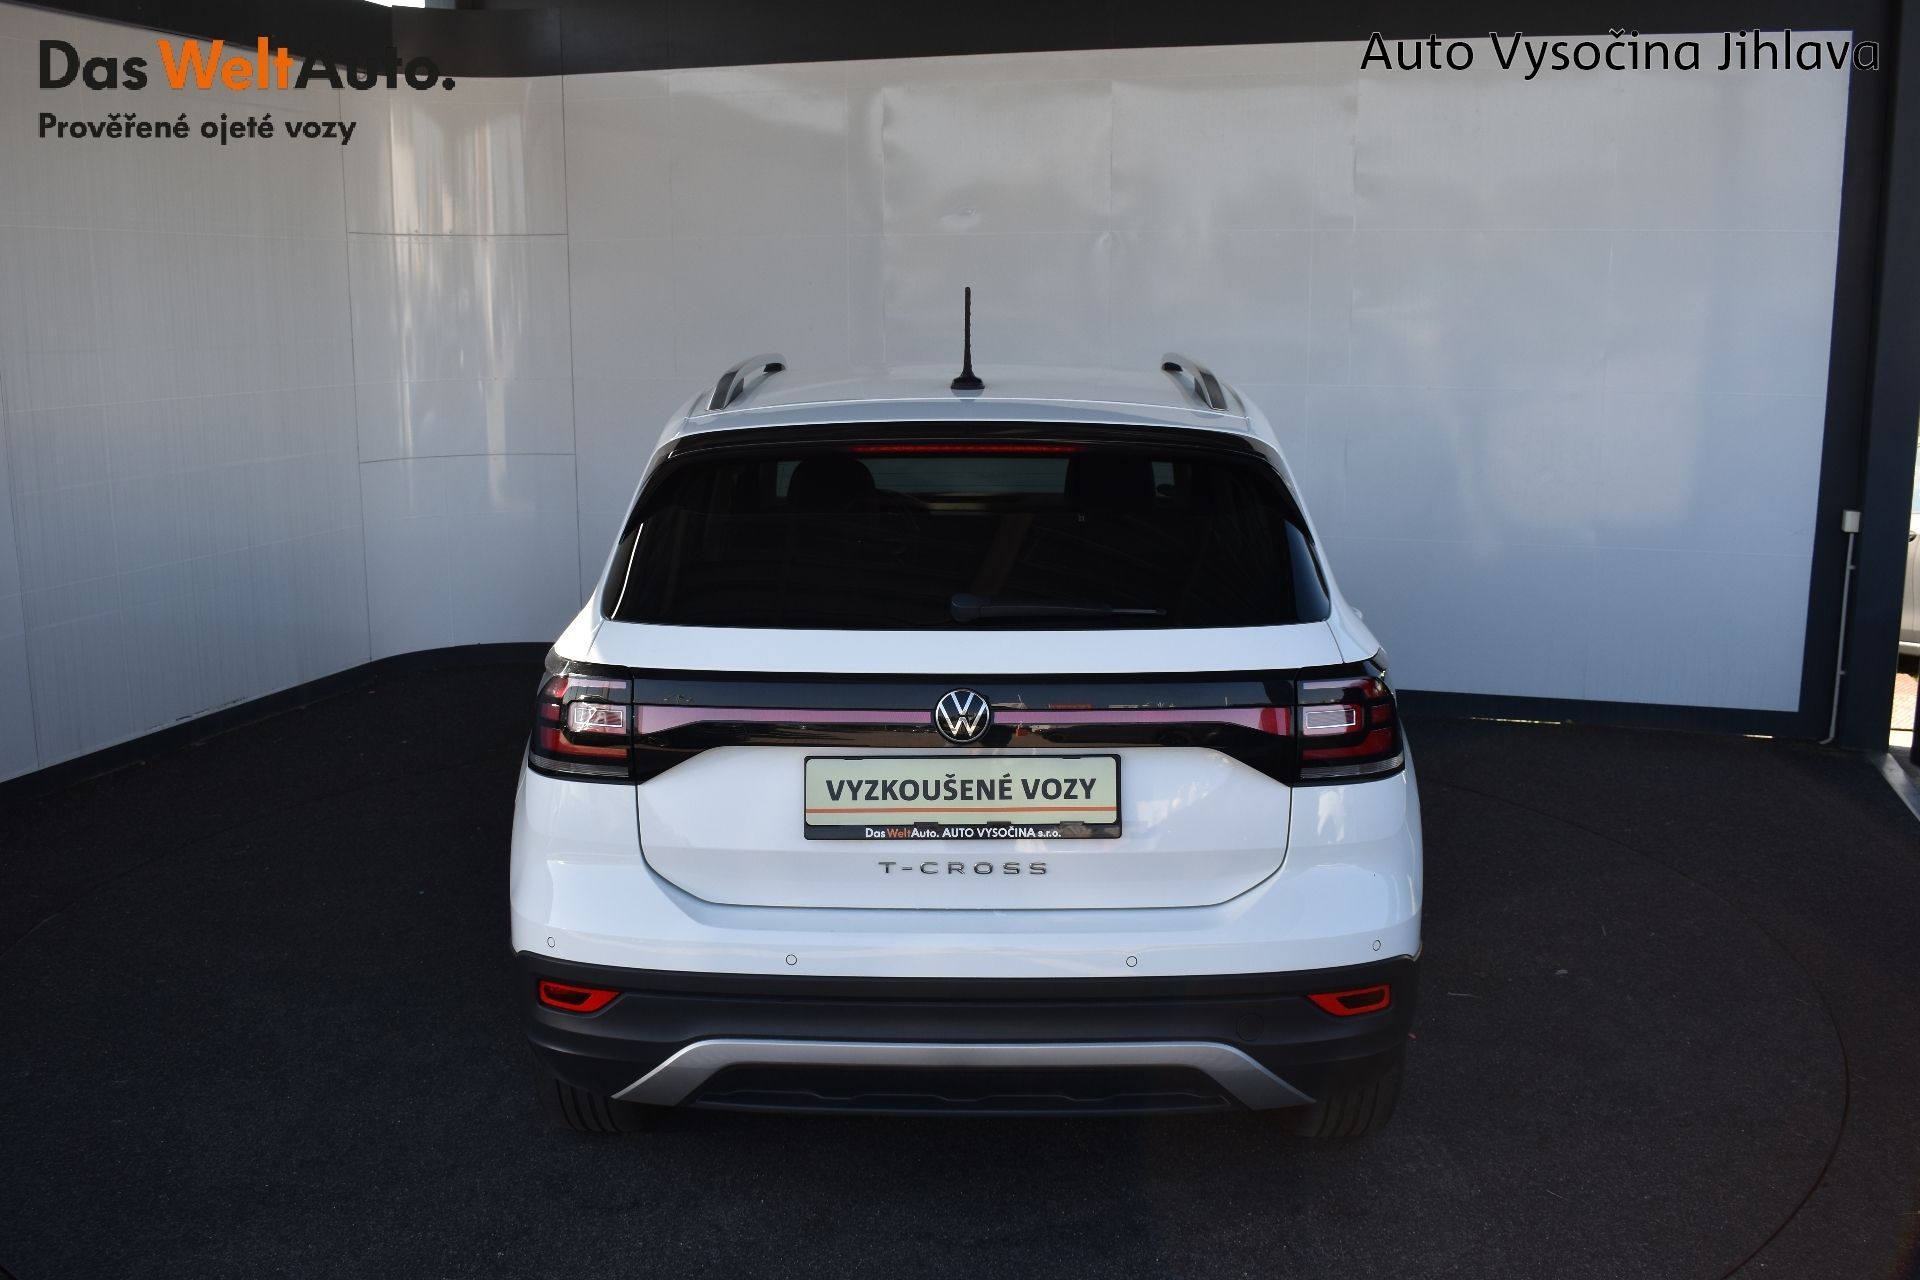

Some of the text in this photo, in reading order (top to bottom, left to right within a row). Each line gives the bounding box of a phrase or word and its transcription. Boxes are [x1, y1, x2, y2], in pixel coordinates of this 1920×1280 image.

[826, 774, 1097, 801] VYZKOUŠENÉ VOZY
[865, 827, 886, 838] Das
[942, 827, 974, 838] AUTO
[976, 825, 1036, 838] VYSOČINA
[1038, 829, 1061, 838] s.r.o.
[878, 861, 1048, 875] T-CROSS
